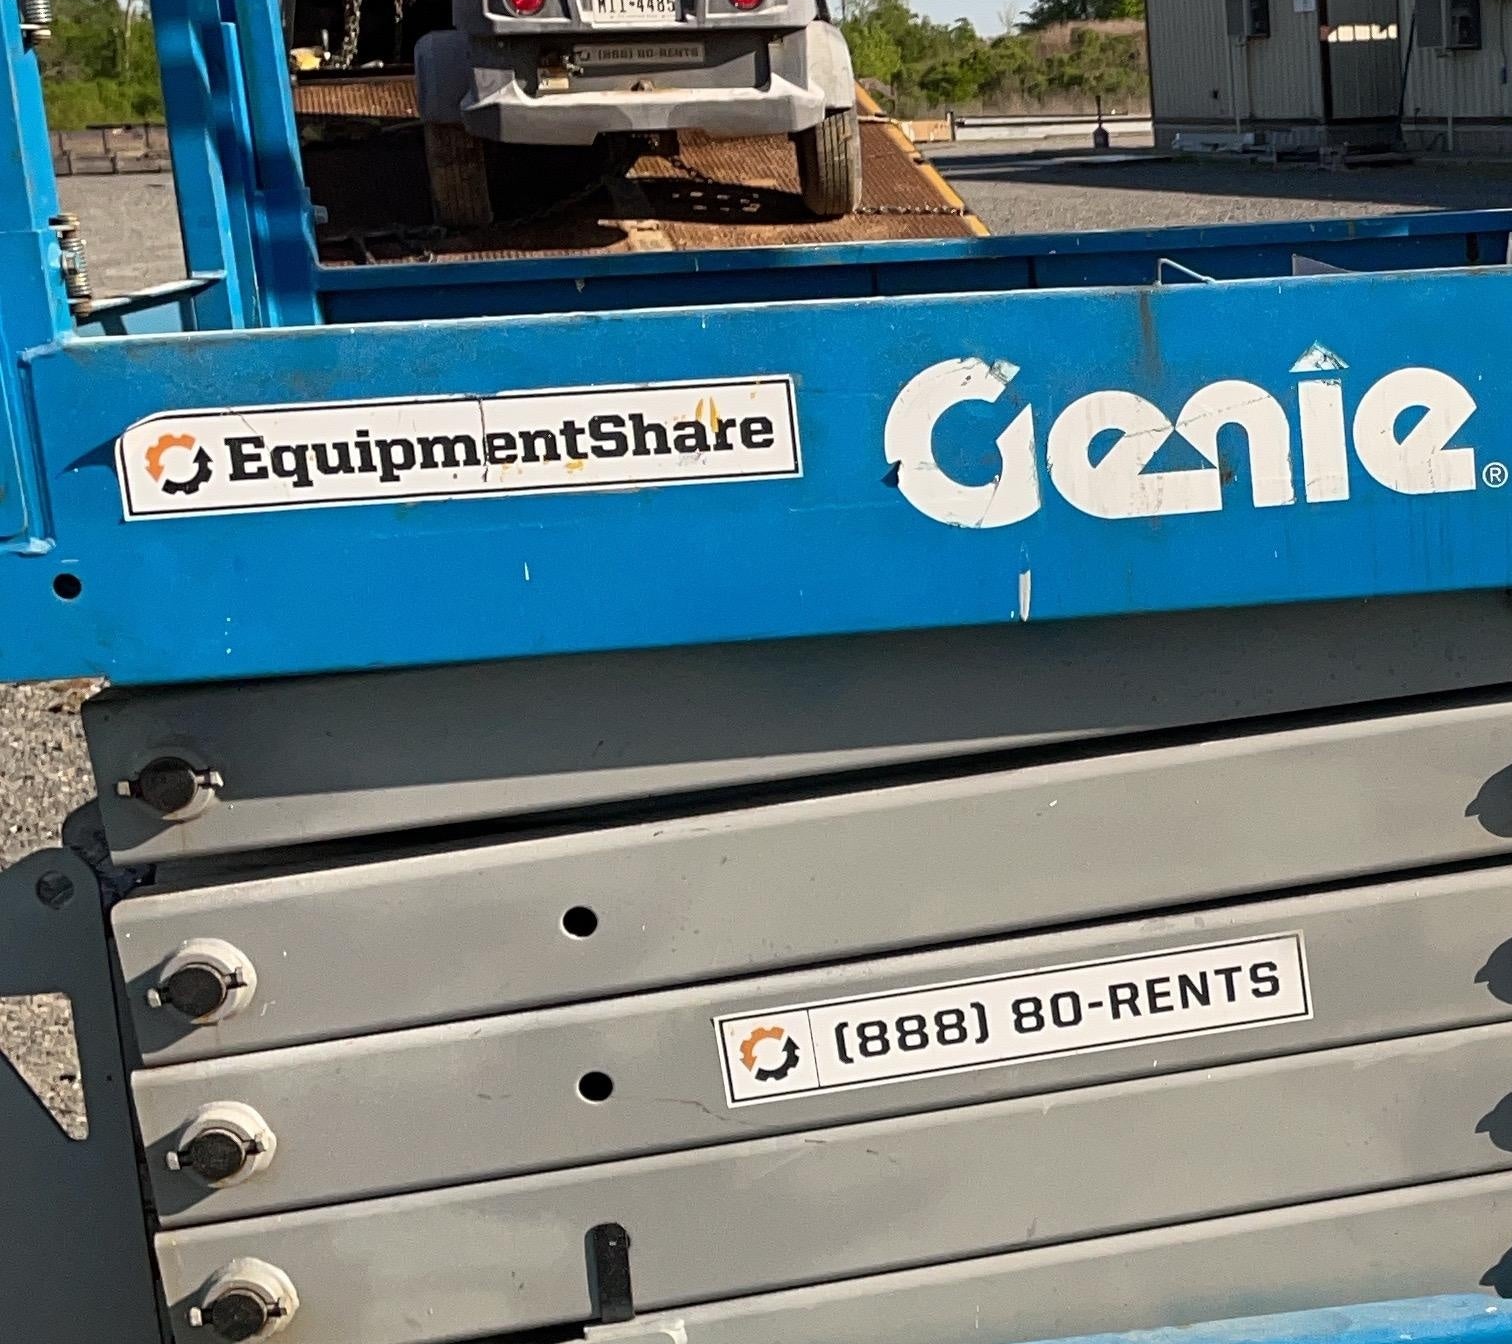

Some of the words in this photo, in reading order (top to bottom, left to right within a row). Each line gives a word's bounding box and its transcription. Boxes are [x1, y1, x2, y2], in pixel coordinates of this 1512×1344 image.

[228, 412, 775, 488] EquipmentShare
[884, 340, 1477, 529] Genie
[834, 1000, 990, 1065] (888)
[1011, 961, 1281, 1034] 80-RENTS
